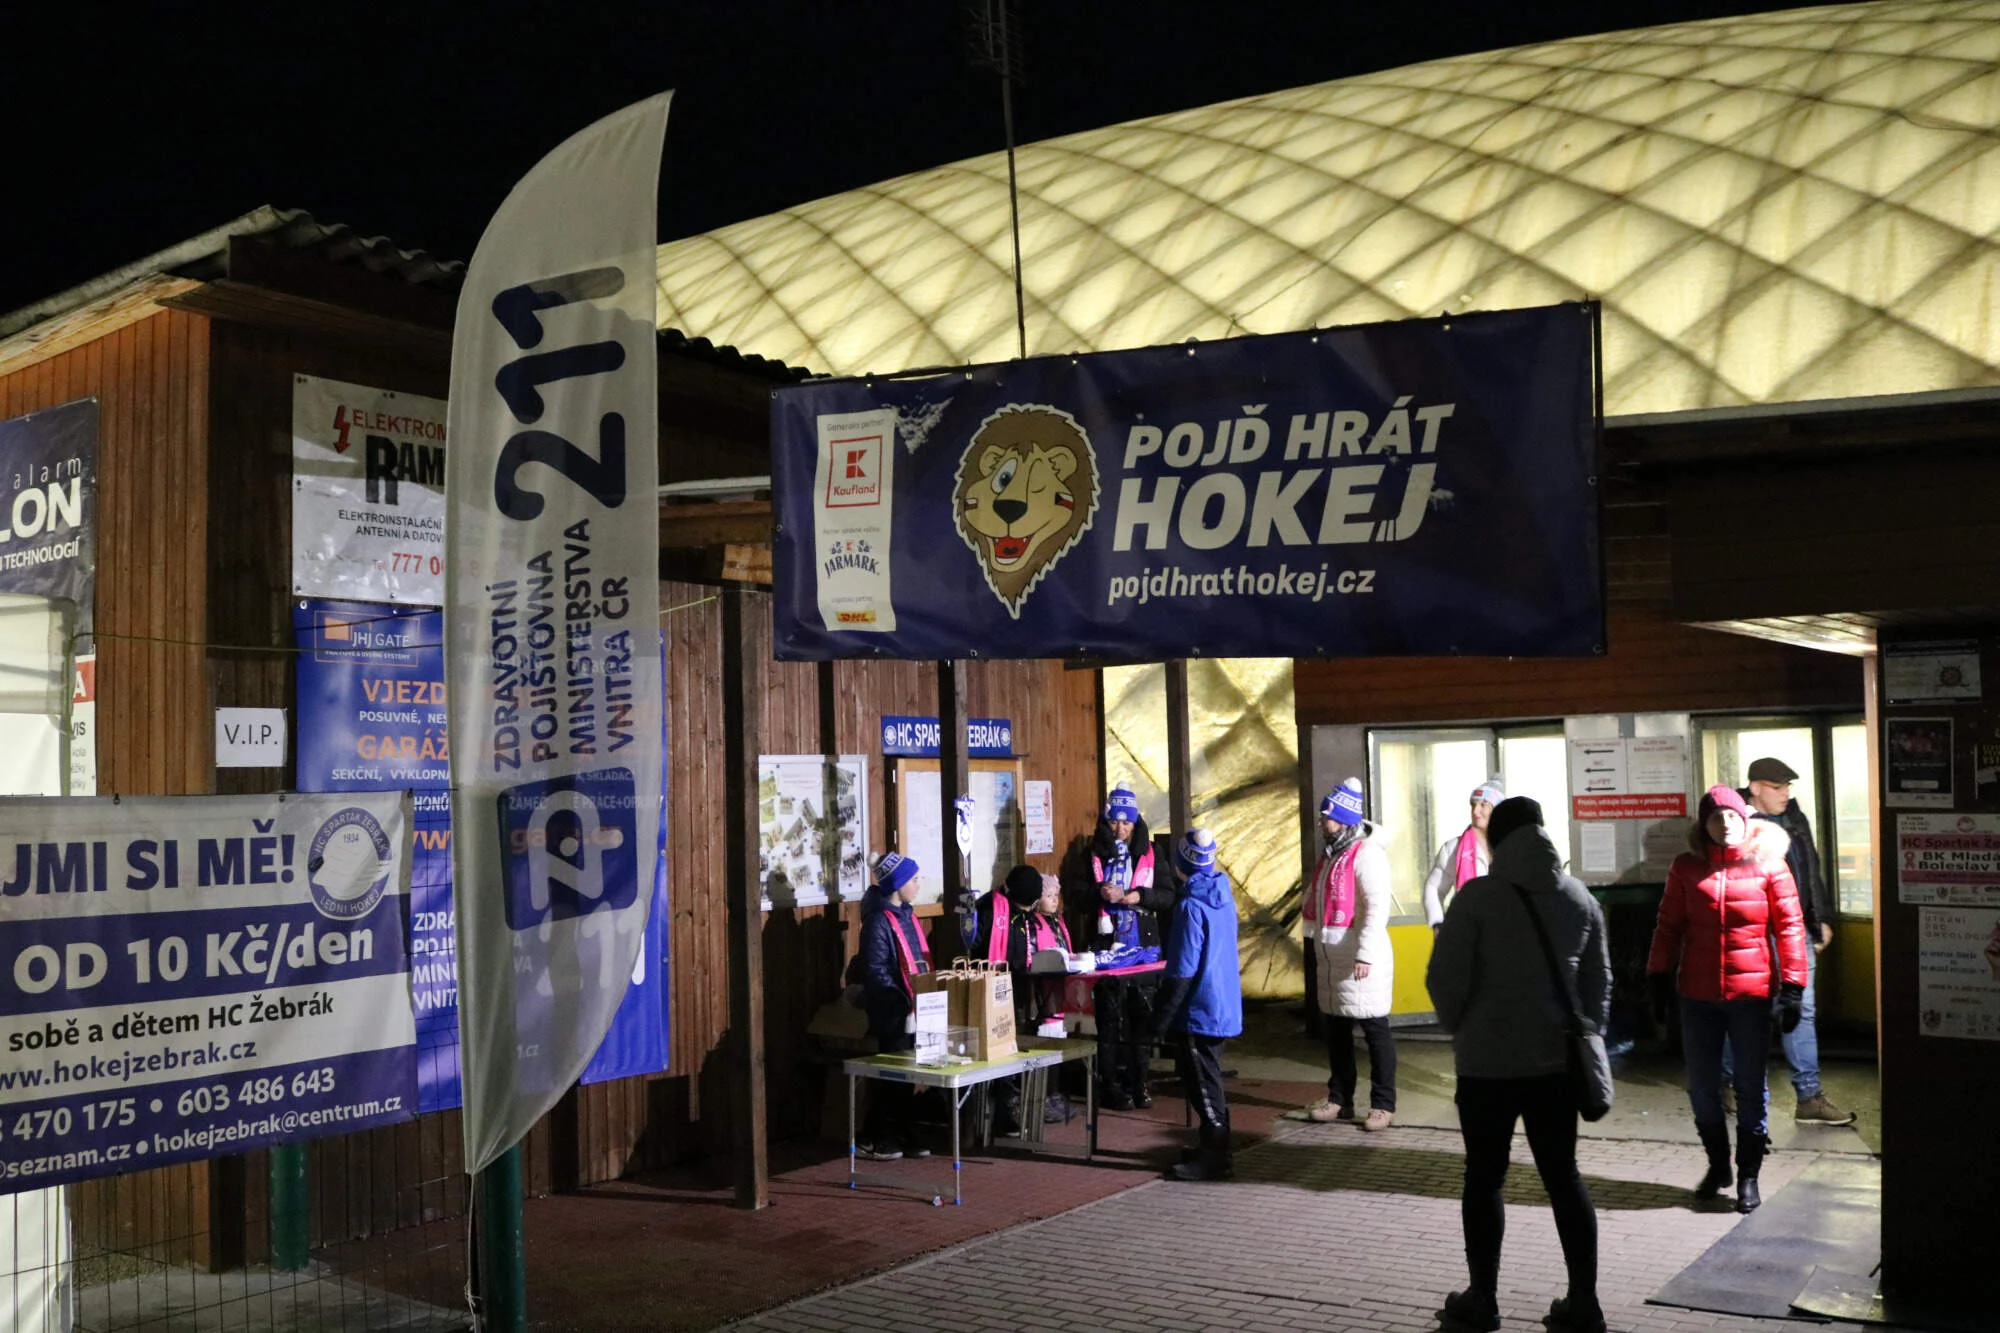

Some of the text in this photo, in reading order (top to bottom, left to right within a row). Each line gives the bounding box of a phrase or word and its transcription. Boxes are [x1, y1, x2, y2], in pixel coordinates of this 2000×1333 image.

[491, 265, 626, 521] 211
[1123, 395, 1456, 469] POJĎ HRÁT
[833, 483, 875, 497] Kaufland
[1113, 462, 1438, 552] HOKEJ
[403, 528, 411, 540] A
[391, 552, 424, 575] 777
[430, 556, 446, 577] 0
[824, 554, 879, 579] JARMARK
[1108, 562, 1376, 605] pojdhrathokej.cz
[375, 634, 409, 649] GATE
[562, 517, 598, 755] MINISTERSTVA
[592, 575, 633, 754] VNITRA ČR
[493, 580, 521, 773] ZDRAVOTNÍ
[224, 724, 279, 746] V.I.P.
[359, 710, 421, 725] POSUVNÉ,
[897, 723, 912, 747] HC
[967, 720, 1001, 748] EBRÁK
[332, 766, 382, 781] SEKČNÍ,
[0, 818, 296, 897] JMI SI MĚ!
[13, 921, 373, 994] OD 10 Kč/den
[9, 992, 334, 1052] sobě a dětem HC Žebrák
[13, 1110, 72, 1142] 470
[82, 1098, 136, 1131] 175
[177, 1084, 230, 1117] 603
[239, 1075, 284, 1106] 486
[291, 1067, 335, 1097] 643
[154, 1095, 402, 1162] hokejzebrak@centrum.cz
